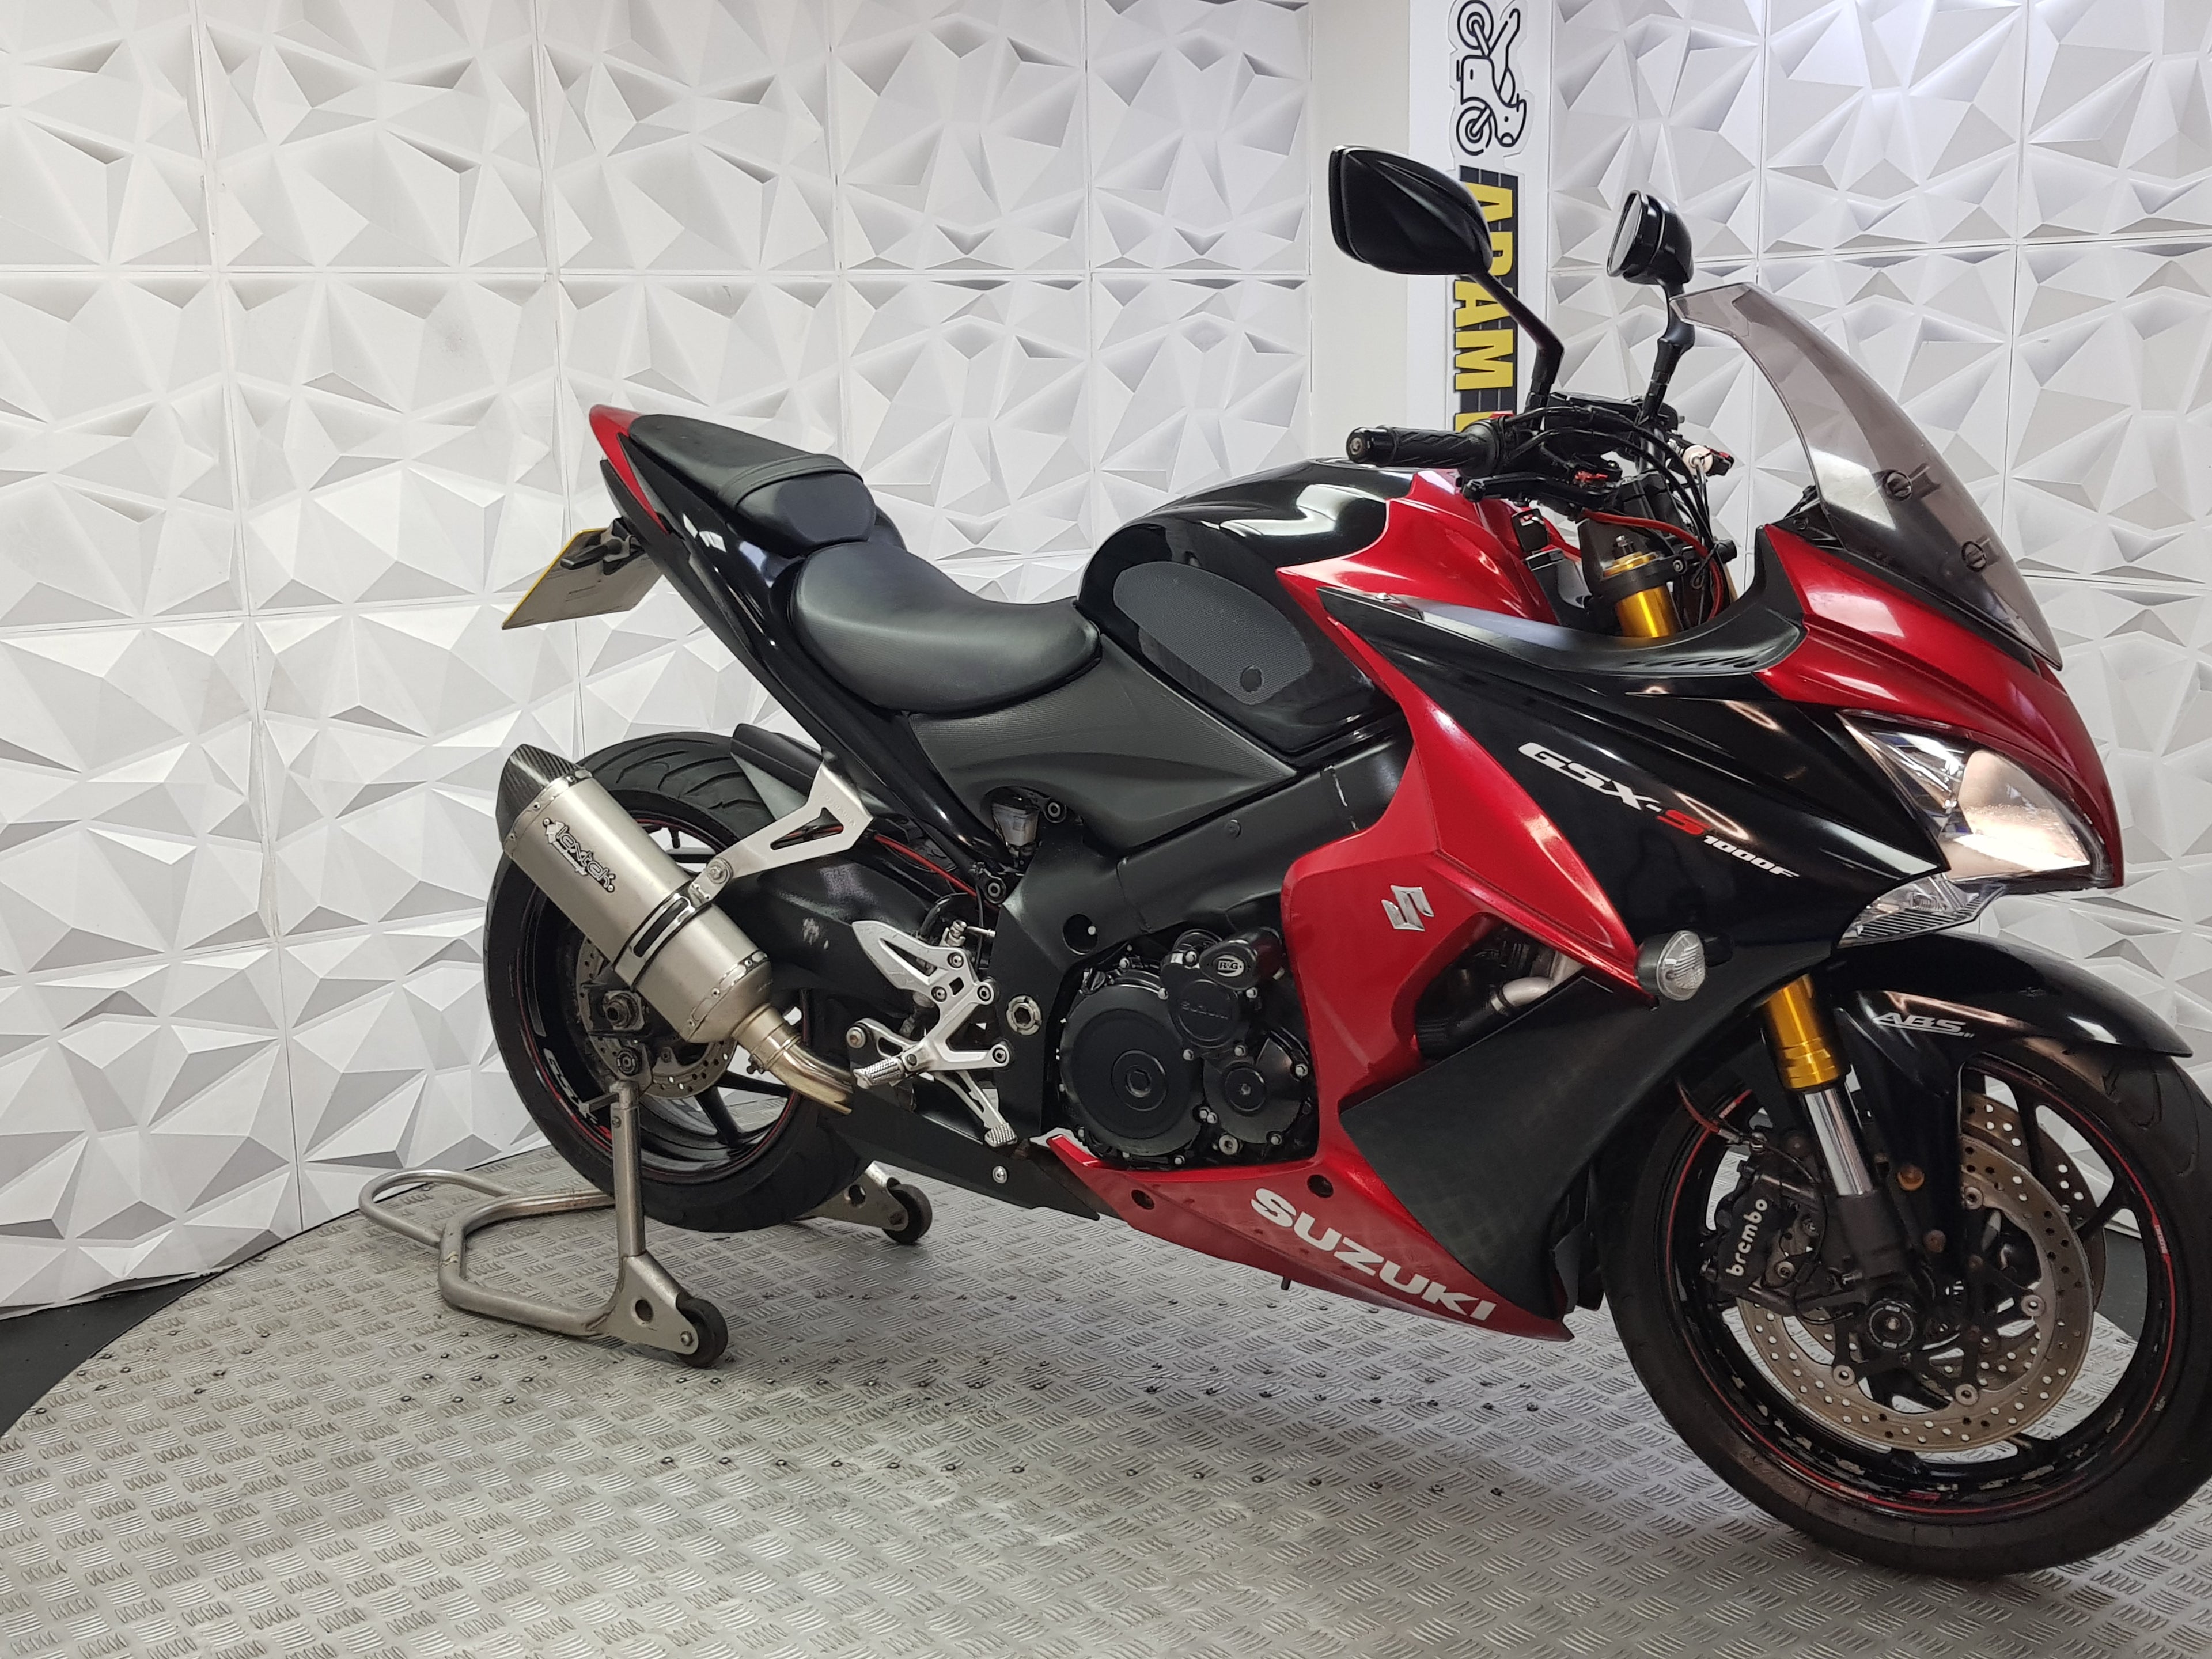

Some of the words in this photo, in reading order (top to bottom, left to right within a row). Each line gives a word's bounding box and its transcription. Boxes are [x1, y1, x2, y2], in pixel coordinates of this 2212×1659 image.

[1518, 741, 1711, 836] GSX-S
[1703, 835, 1800, 878] 1000F
[1218, 960, 1238, 971] R&G
[1872, 1012, 1967, 1033] ABS
[1250, 1187, 1498, 1321] SUZUKI
[1725, 1199, 1768, 1277] brembo
